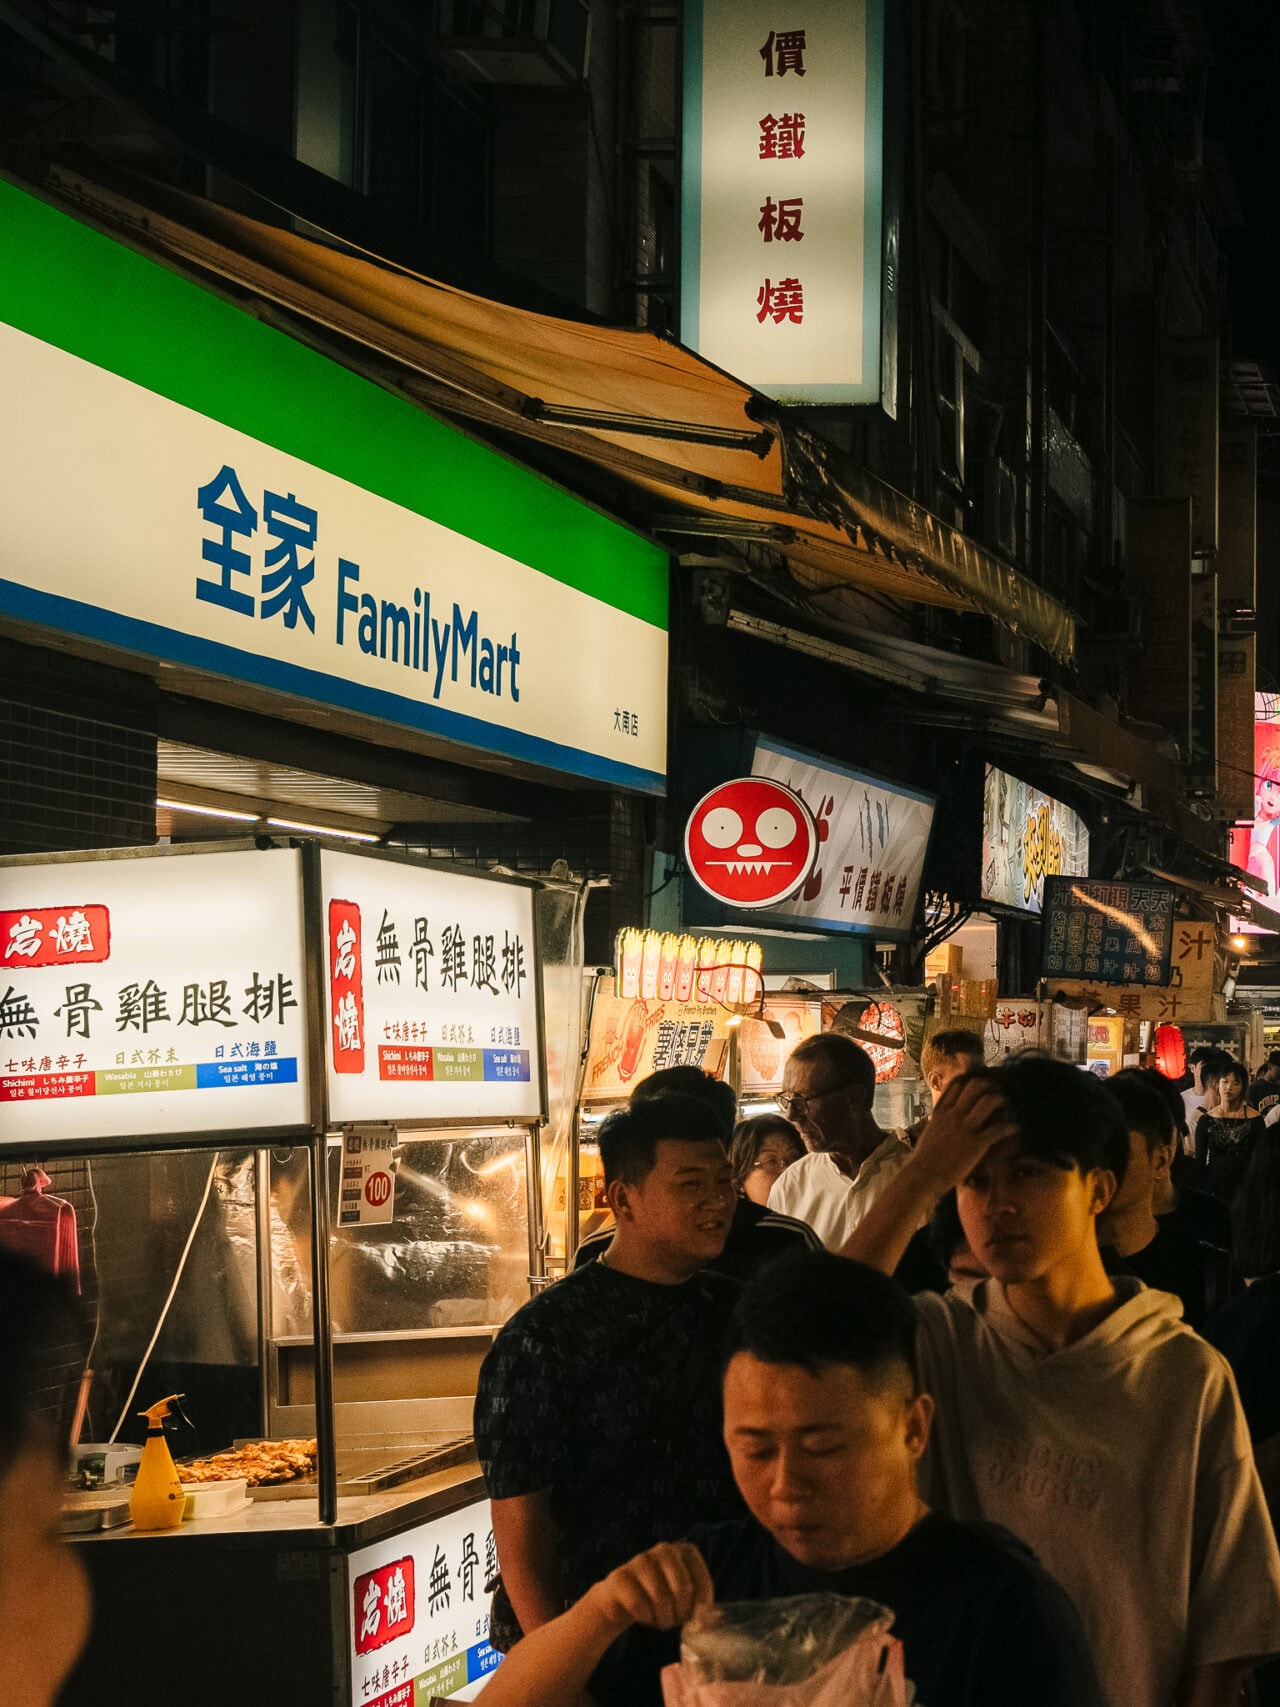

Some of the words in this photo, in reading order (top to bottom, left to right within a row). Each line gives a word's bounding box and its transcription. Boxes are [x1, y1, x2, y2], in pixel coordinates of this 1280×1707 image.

[757, 30, 807, 325] 價鐵板燒
[196, 465, 318, 634] 全家
[336, 557, 521, 703] FamilyMart
[613, 707, 639, 738] 大南店
[4, 911, 94, 960] 岩燒
[375, 908, 527, 999] 無骨雞腿排
[335, 919, 363, 1052] 岩燒
[0, 972, 298, 1039] 無骨雞腿排
[384, 1020, 428, 1043] 七味唐辛子
[441, 1024, 475, 1044] 日式芥末
[490, 1026, 521, 1046] 日式海鹽
[5, 1053, 87, 1073] 七味唐辛子
[115, 1047, 179, 1065] 日式芥末
[215, 1040, 278, 1058] 日式海鹽
[2, 1079, 35, 1088] Shichimi
[218, 1065, 232, 1074] Sea
[234, 1064, 247, 1073] salt
[368, 1176, 388, 1201] 100
[361, 1567, 408, 1642] 岩燒
[424, 1630, 459, 1665] 日式芥末
[361, 1654, 410, 1697] 七味唐辛子
